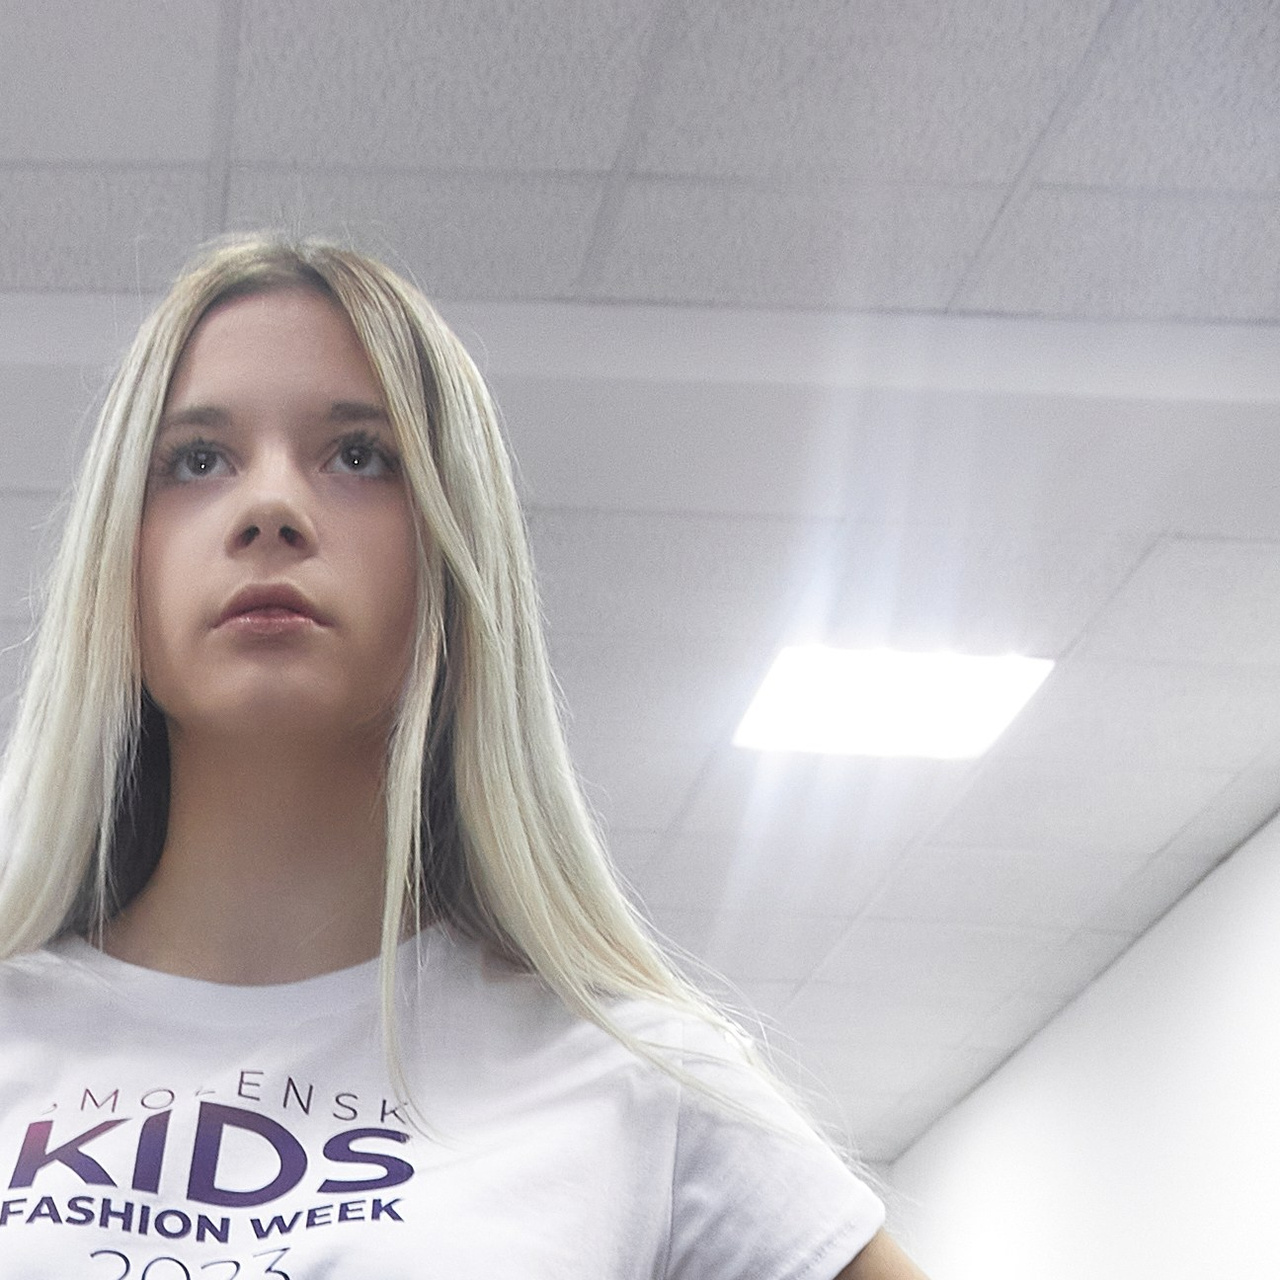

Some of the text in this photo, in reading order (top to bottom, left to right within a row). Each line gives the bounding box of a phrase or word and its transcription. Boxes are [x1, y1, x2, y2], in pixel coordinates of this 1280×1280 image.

[41, 1070, 408, 1124] MOENSK
[8, 1101, 415, 1208] KIDS
[0, 1195, 405, 1244] FASHION WEEK
